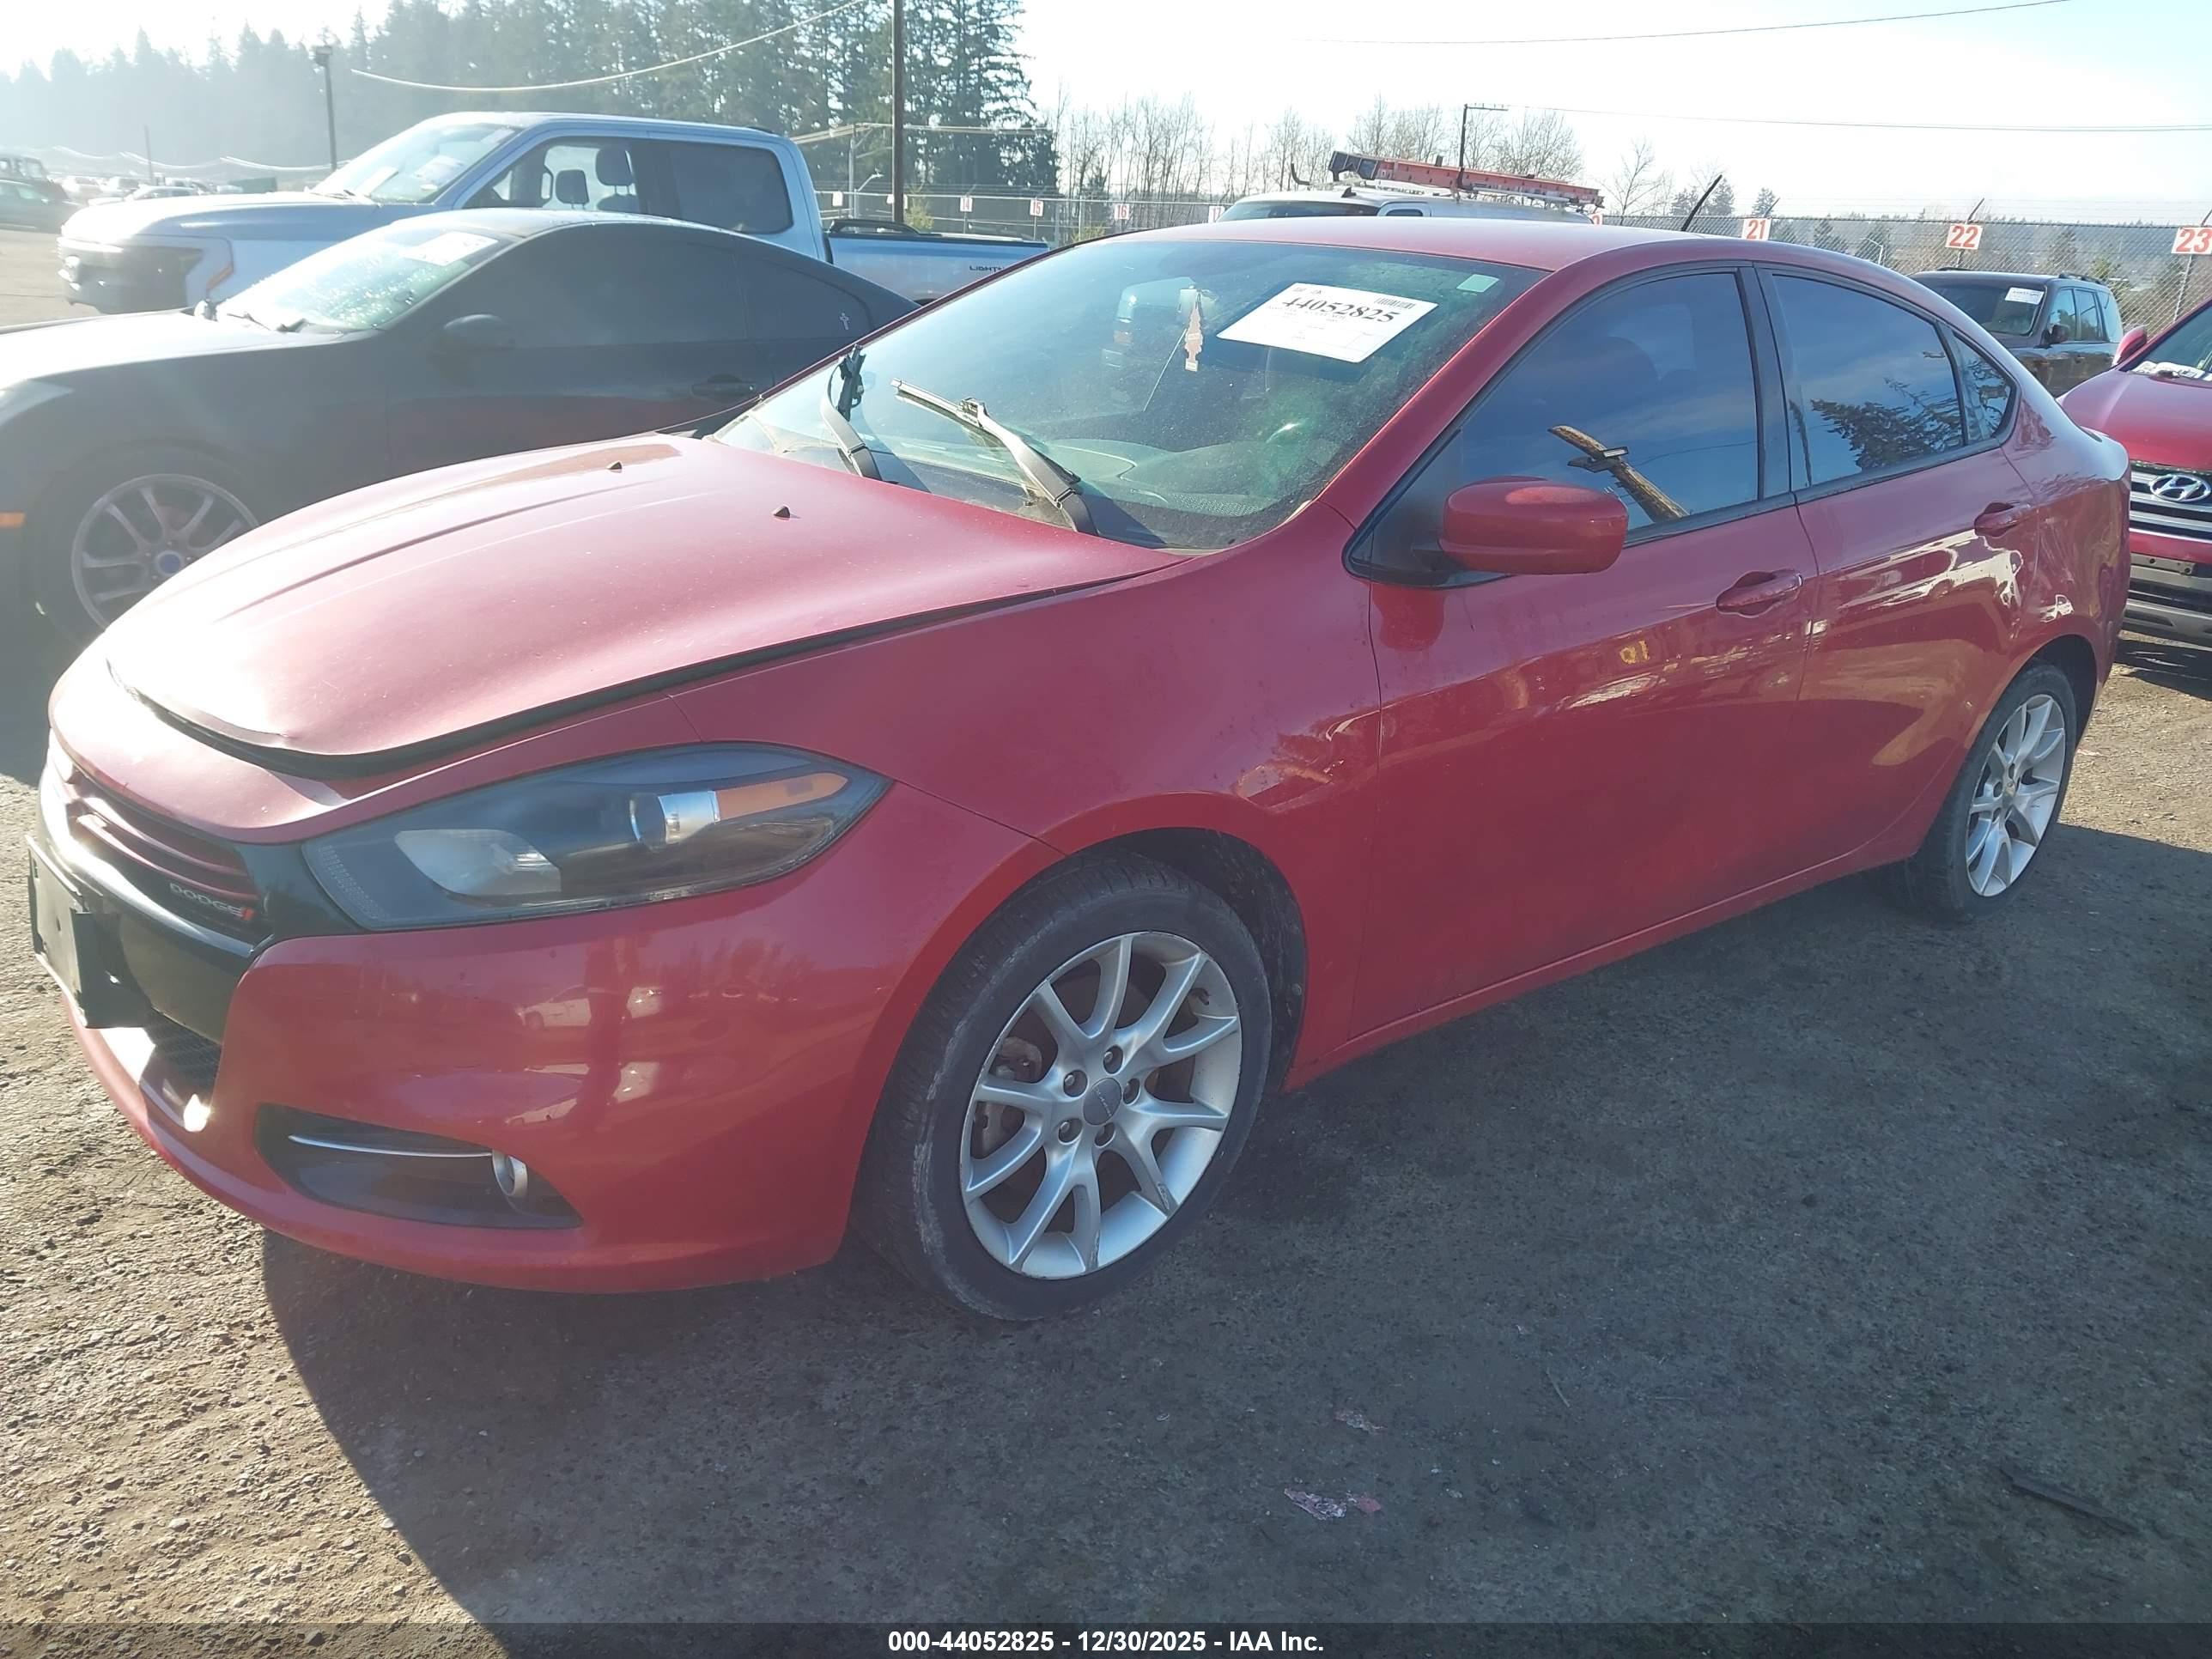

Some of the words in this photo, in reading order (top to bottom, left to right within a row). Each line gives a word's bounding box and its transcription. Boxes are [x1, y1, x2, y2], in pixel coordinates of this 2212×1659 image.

[1032, 201, 1042, 215] 15
[1116, 204, 1127, 218] 16
[1746, 219, 1766, 240] 21
[1949, 225, 1978, 248] 22
[2175, 228, 2212, 253] 23
[1282, 297, 1401, 323] 44052825
[170, 882, 243, 917] DODGE
